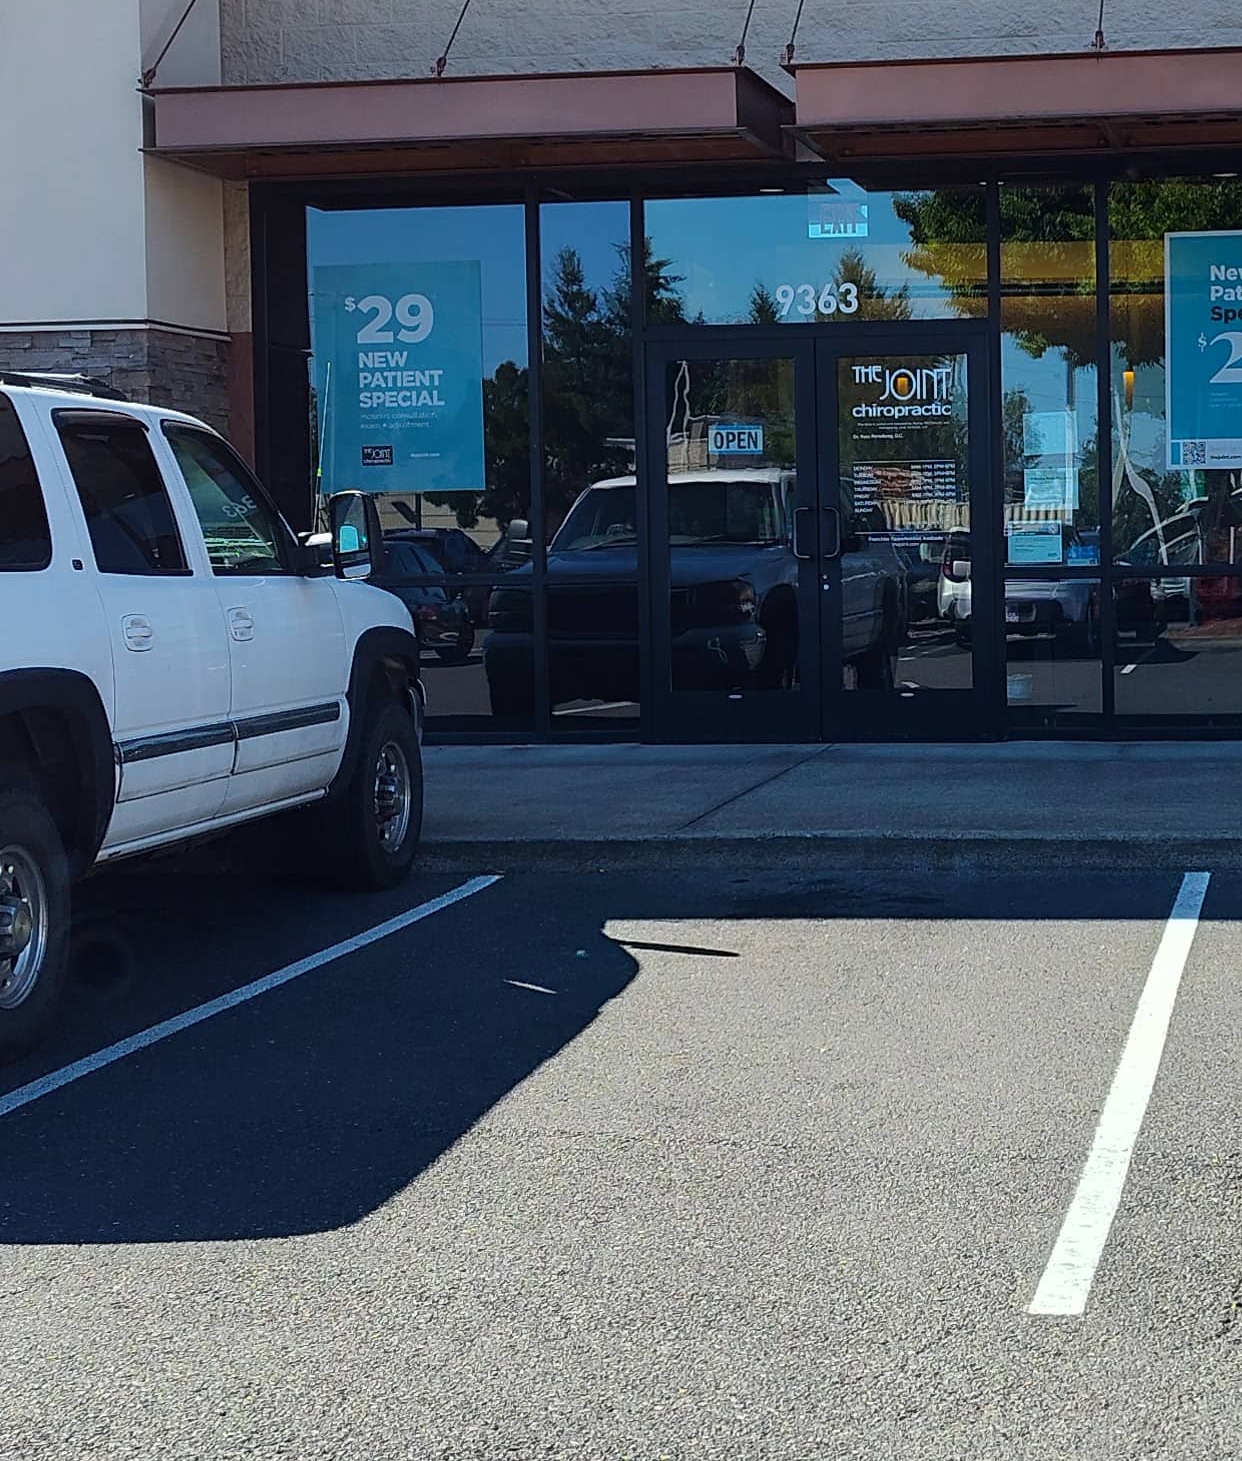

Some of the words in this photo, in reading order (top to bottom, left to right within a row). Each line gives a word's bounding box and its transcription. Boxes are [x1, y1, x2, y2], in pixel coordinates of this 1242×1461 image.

[820, 204, 856, 235] EXIT
[775, 282, 859, 316] 9363
[359, 351, 408, 369] NEW
[359, 369, 443, 388] PATIENT
[851, 365, 882, 383] THE
[359, 390, 445, 408] SPECIAL
[851, 402, 952, 419] chiropractic
[714, 431, 758, 449] OPEN
